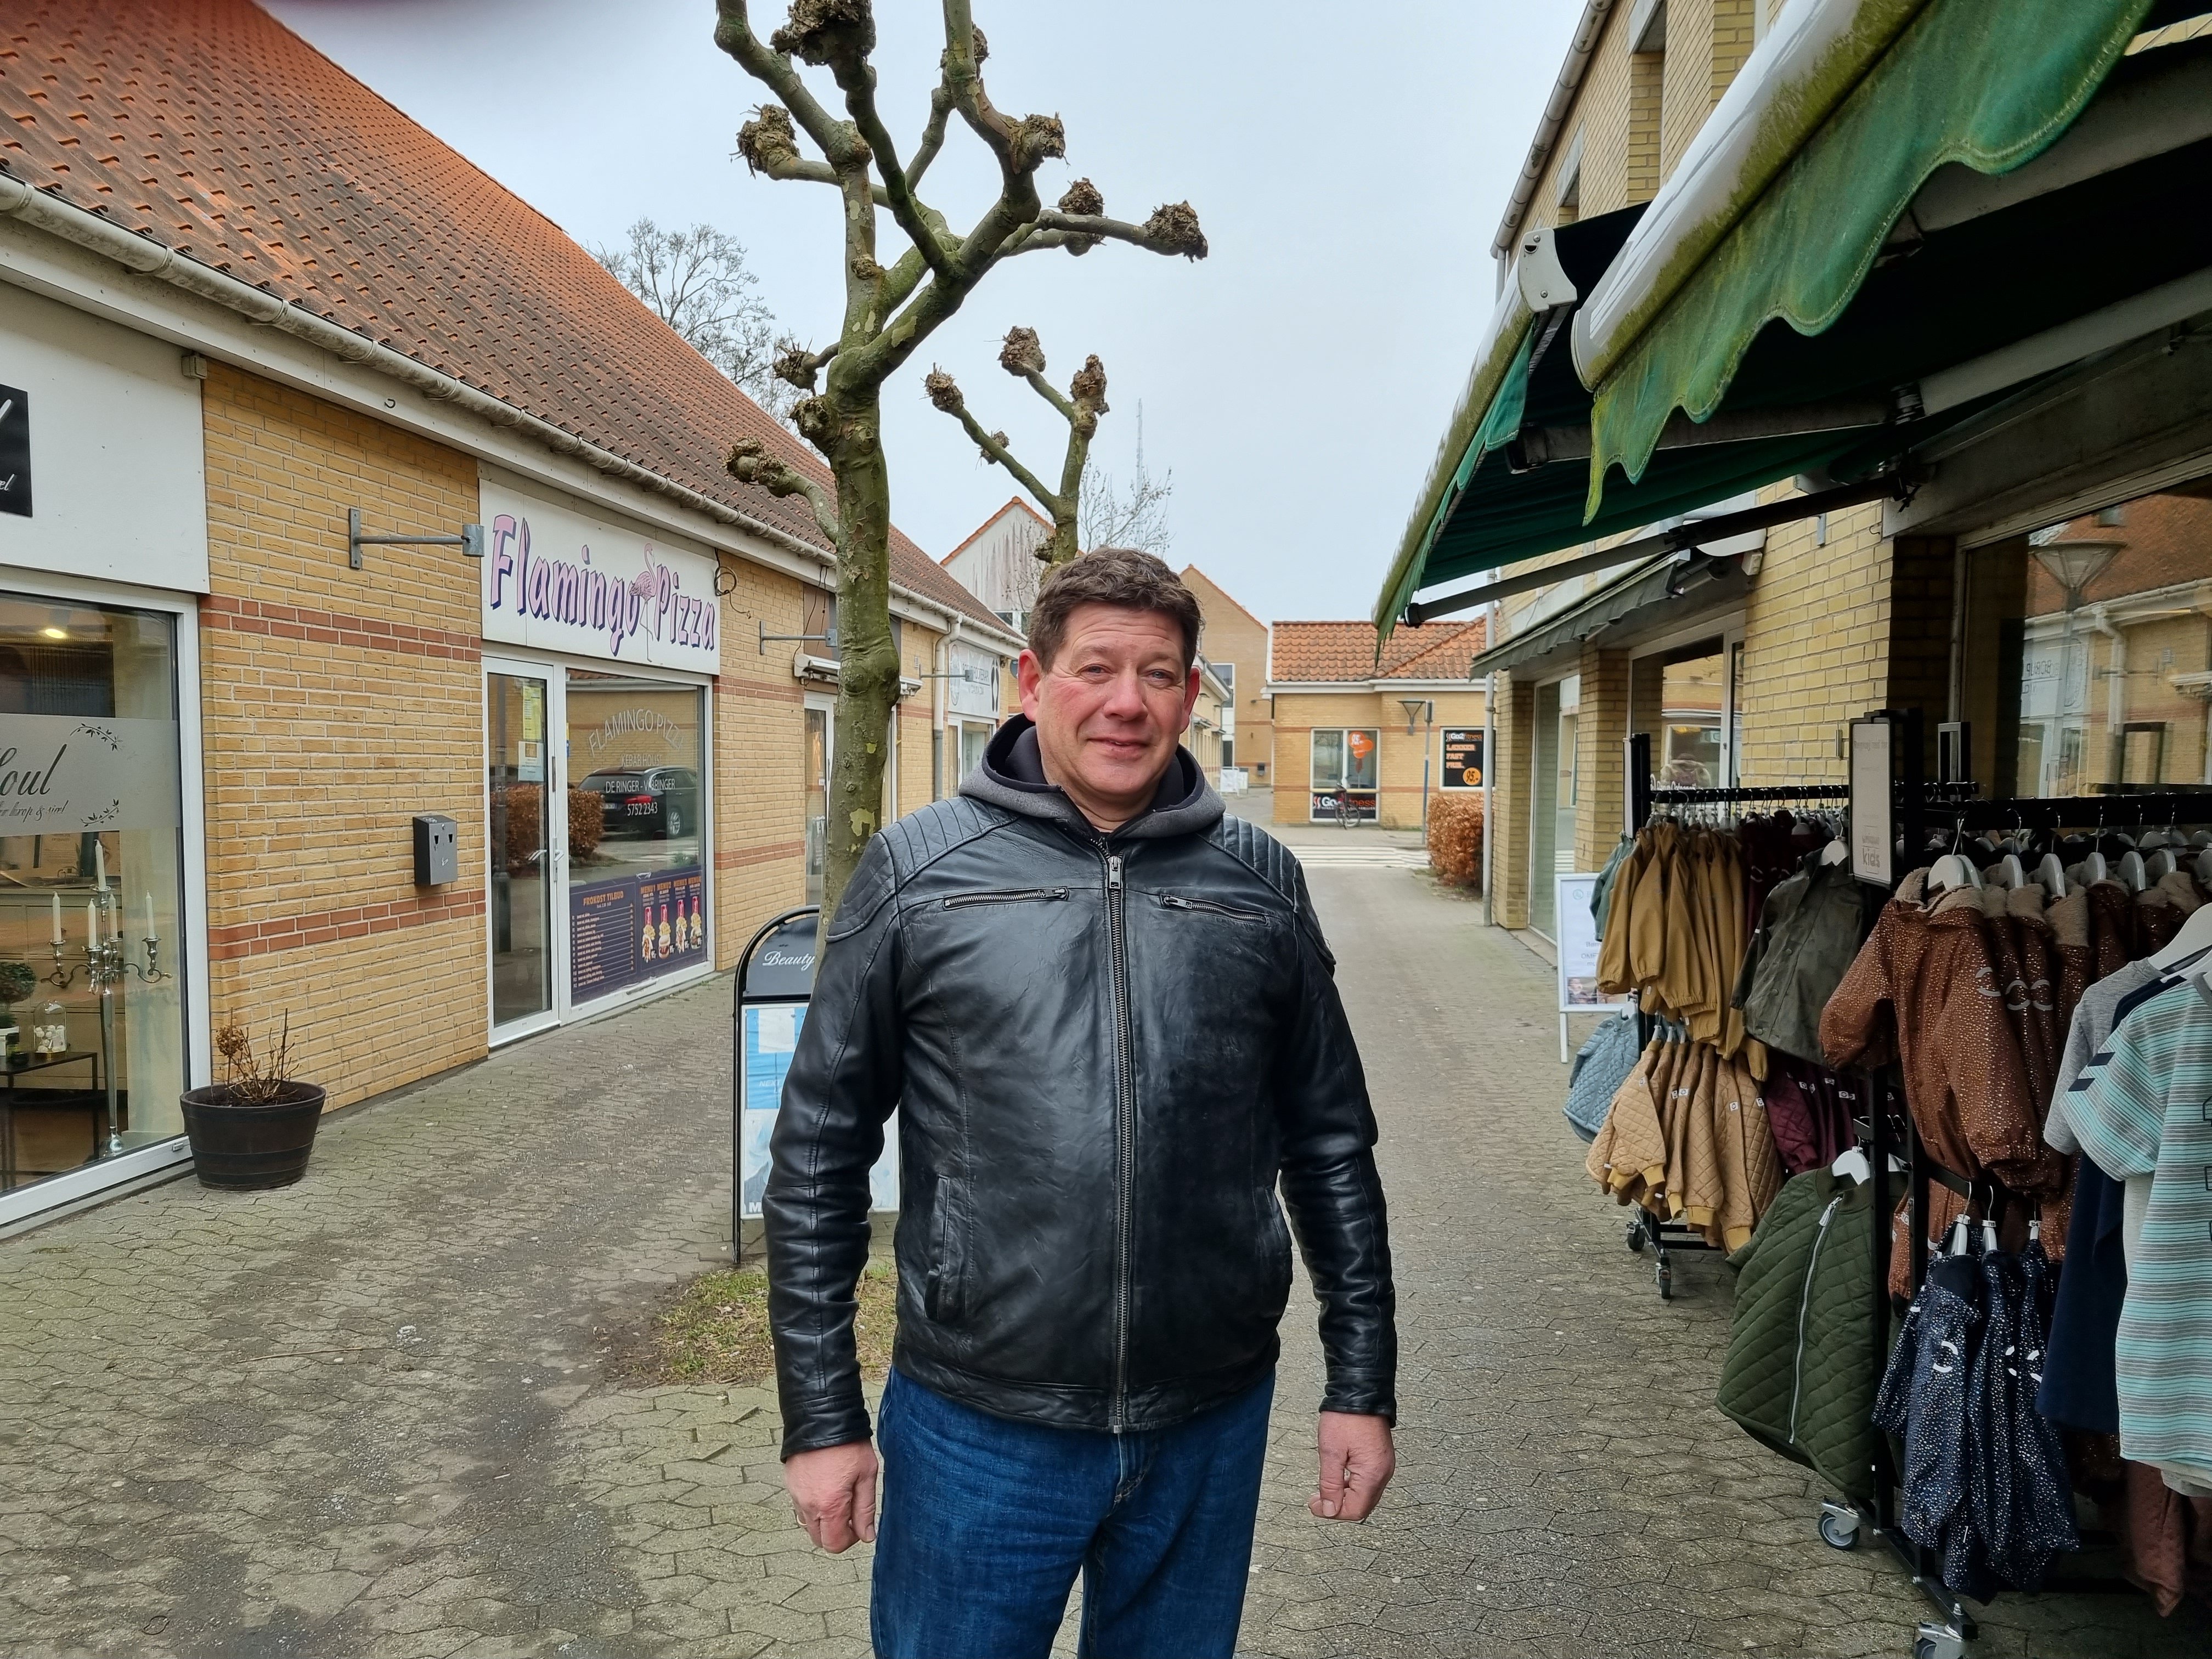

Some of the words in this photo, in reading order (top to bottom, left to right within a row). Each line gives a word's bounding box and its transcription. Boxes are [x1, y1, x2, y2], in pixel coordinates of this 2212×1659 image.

[490, 514, 641, 656] Flamingo
[654, 563, 715, 652] Pizza
[588, 708, 653, 758] FLAMINGO
[621, 754, 641, 767] KEBAB
[606, 781, 615, 793] DE
[616, 780, 639, 793] RINGER
[627, 803, 642, 817] 5752
[643, 802, 658, 815] 2343
[1862, 847, 1881, 868] kids
[583, 894, 606, 906] FROKOST
[762, 951, 815, 972] Beauty
[759, 1079, 780, 1087] NEXT
